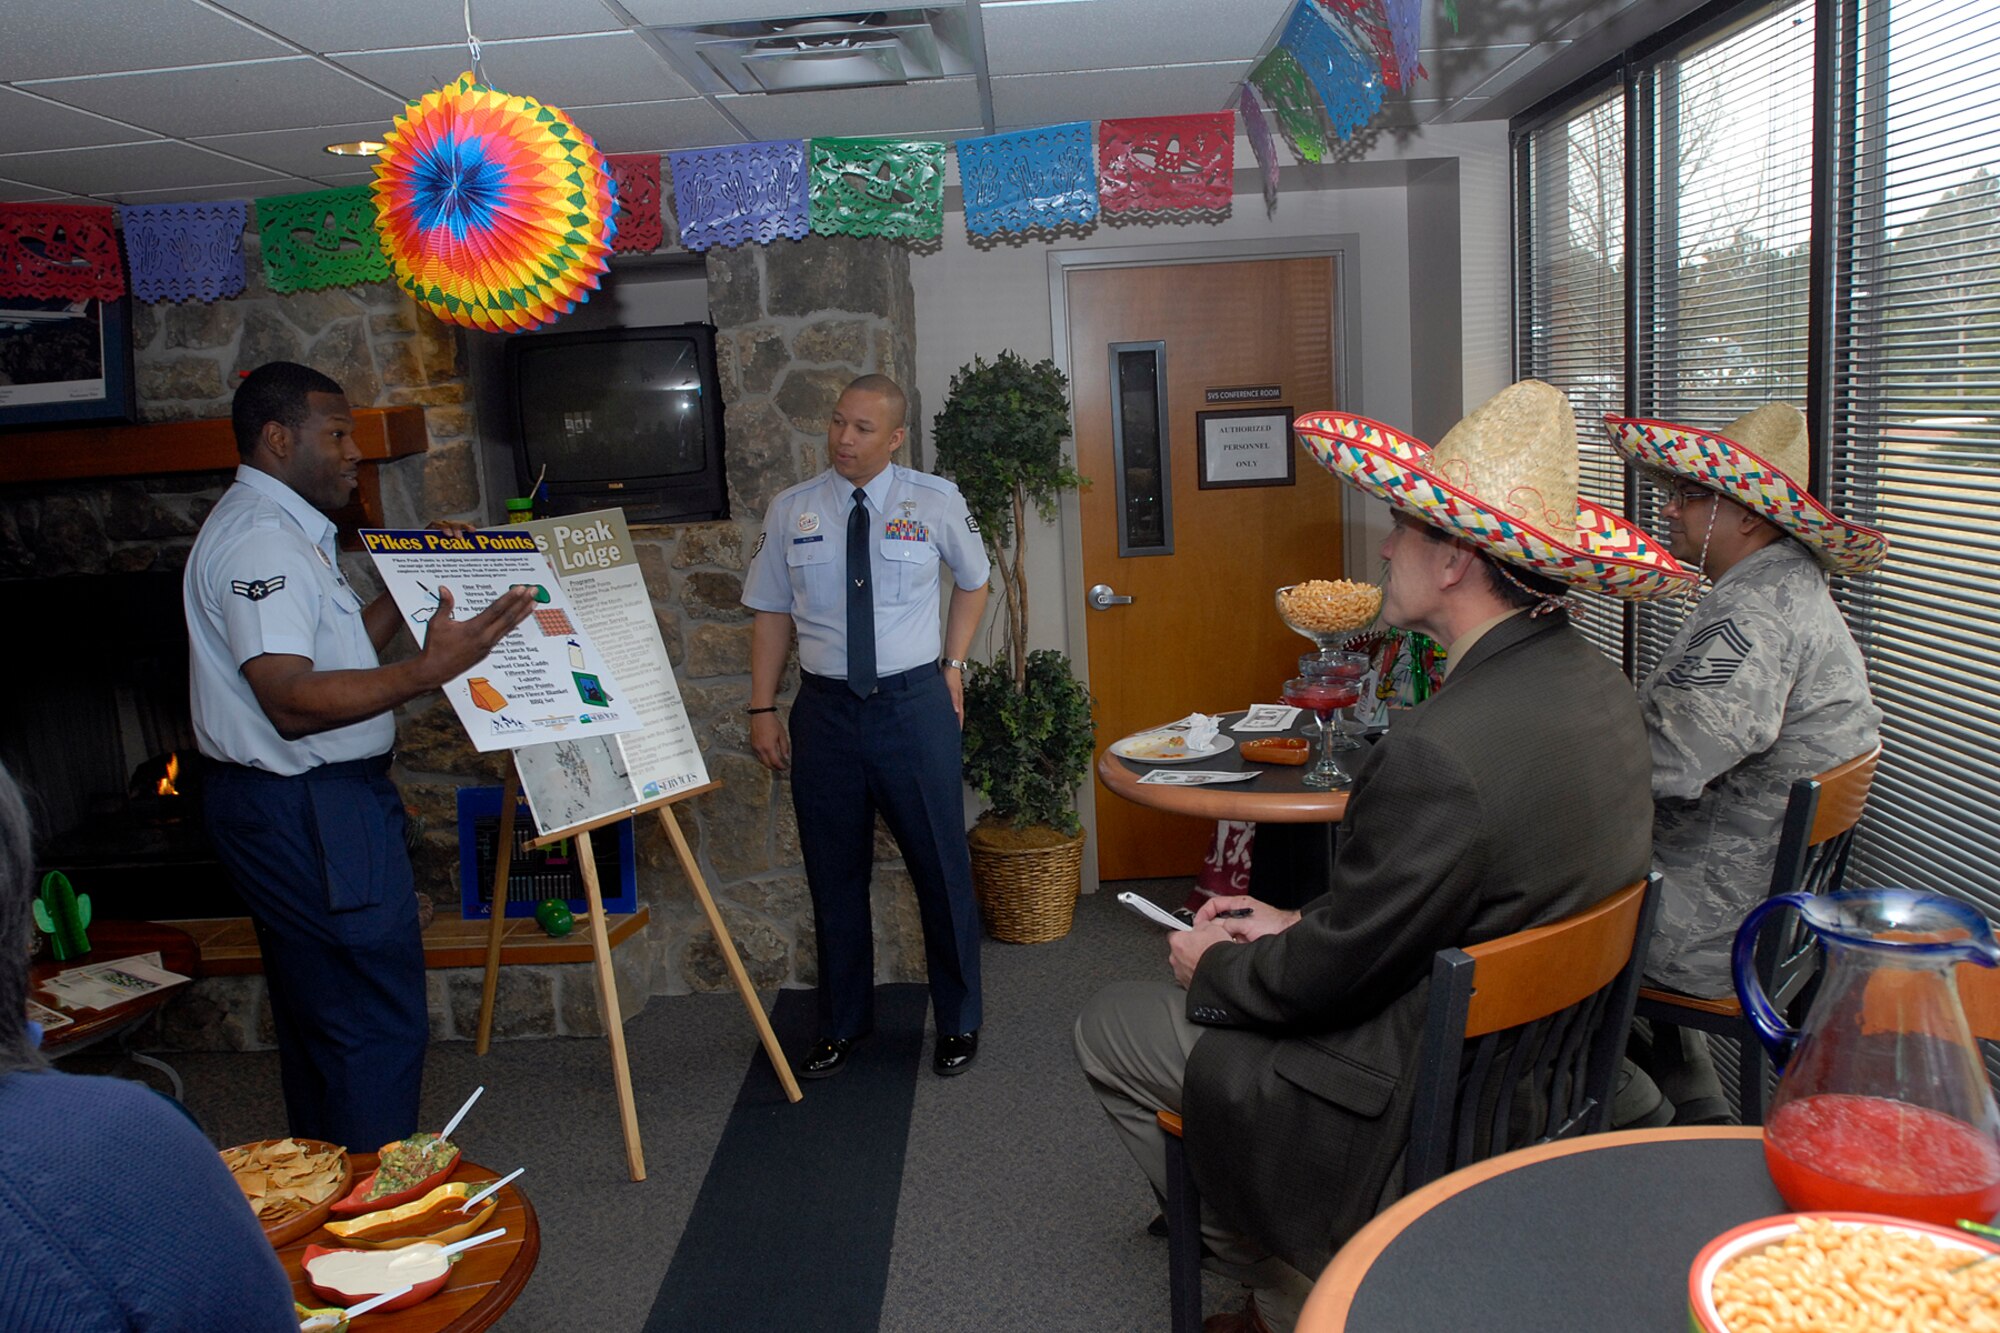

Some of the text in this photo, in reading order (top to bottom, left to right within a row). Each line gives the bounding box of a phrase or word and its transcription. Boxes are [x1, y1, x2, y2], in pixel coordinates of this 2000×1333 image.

[1220, 390, 1259, 399] CONFERENCE
[1219, 424, 1272, 434] AUTHORIZED
[1223, 442, 1270, 451] PERSONNEL
[1236, 460, 1258, 468] ONLY
[554, 520, 614, 548] Peak
[365, 534, 422, 550] Pikes
[424, 534, 476, 550] Peak
[476, 534, 535, 550] Points
[559, 544, 620, 570] Lodge
[659, 772, 698, 789] SERVICES
